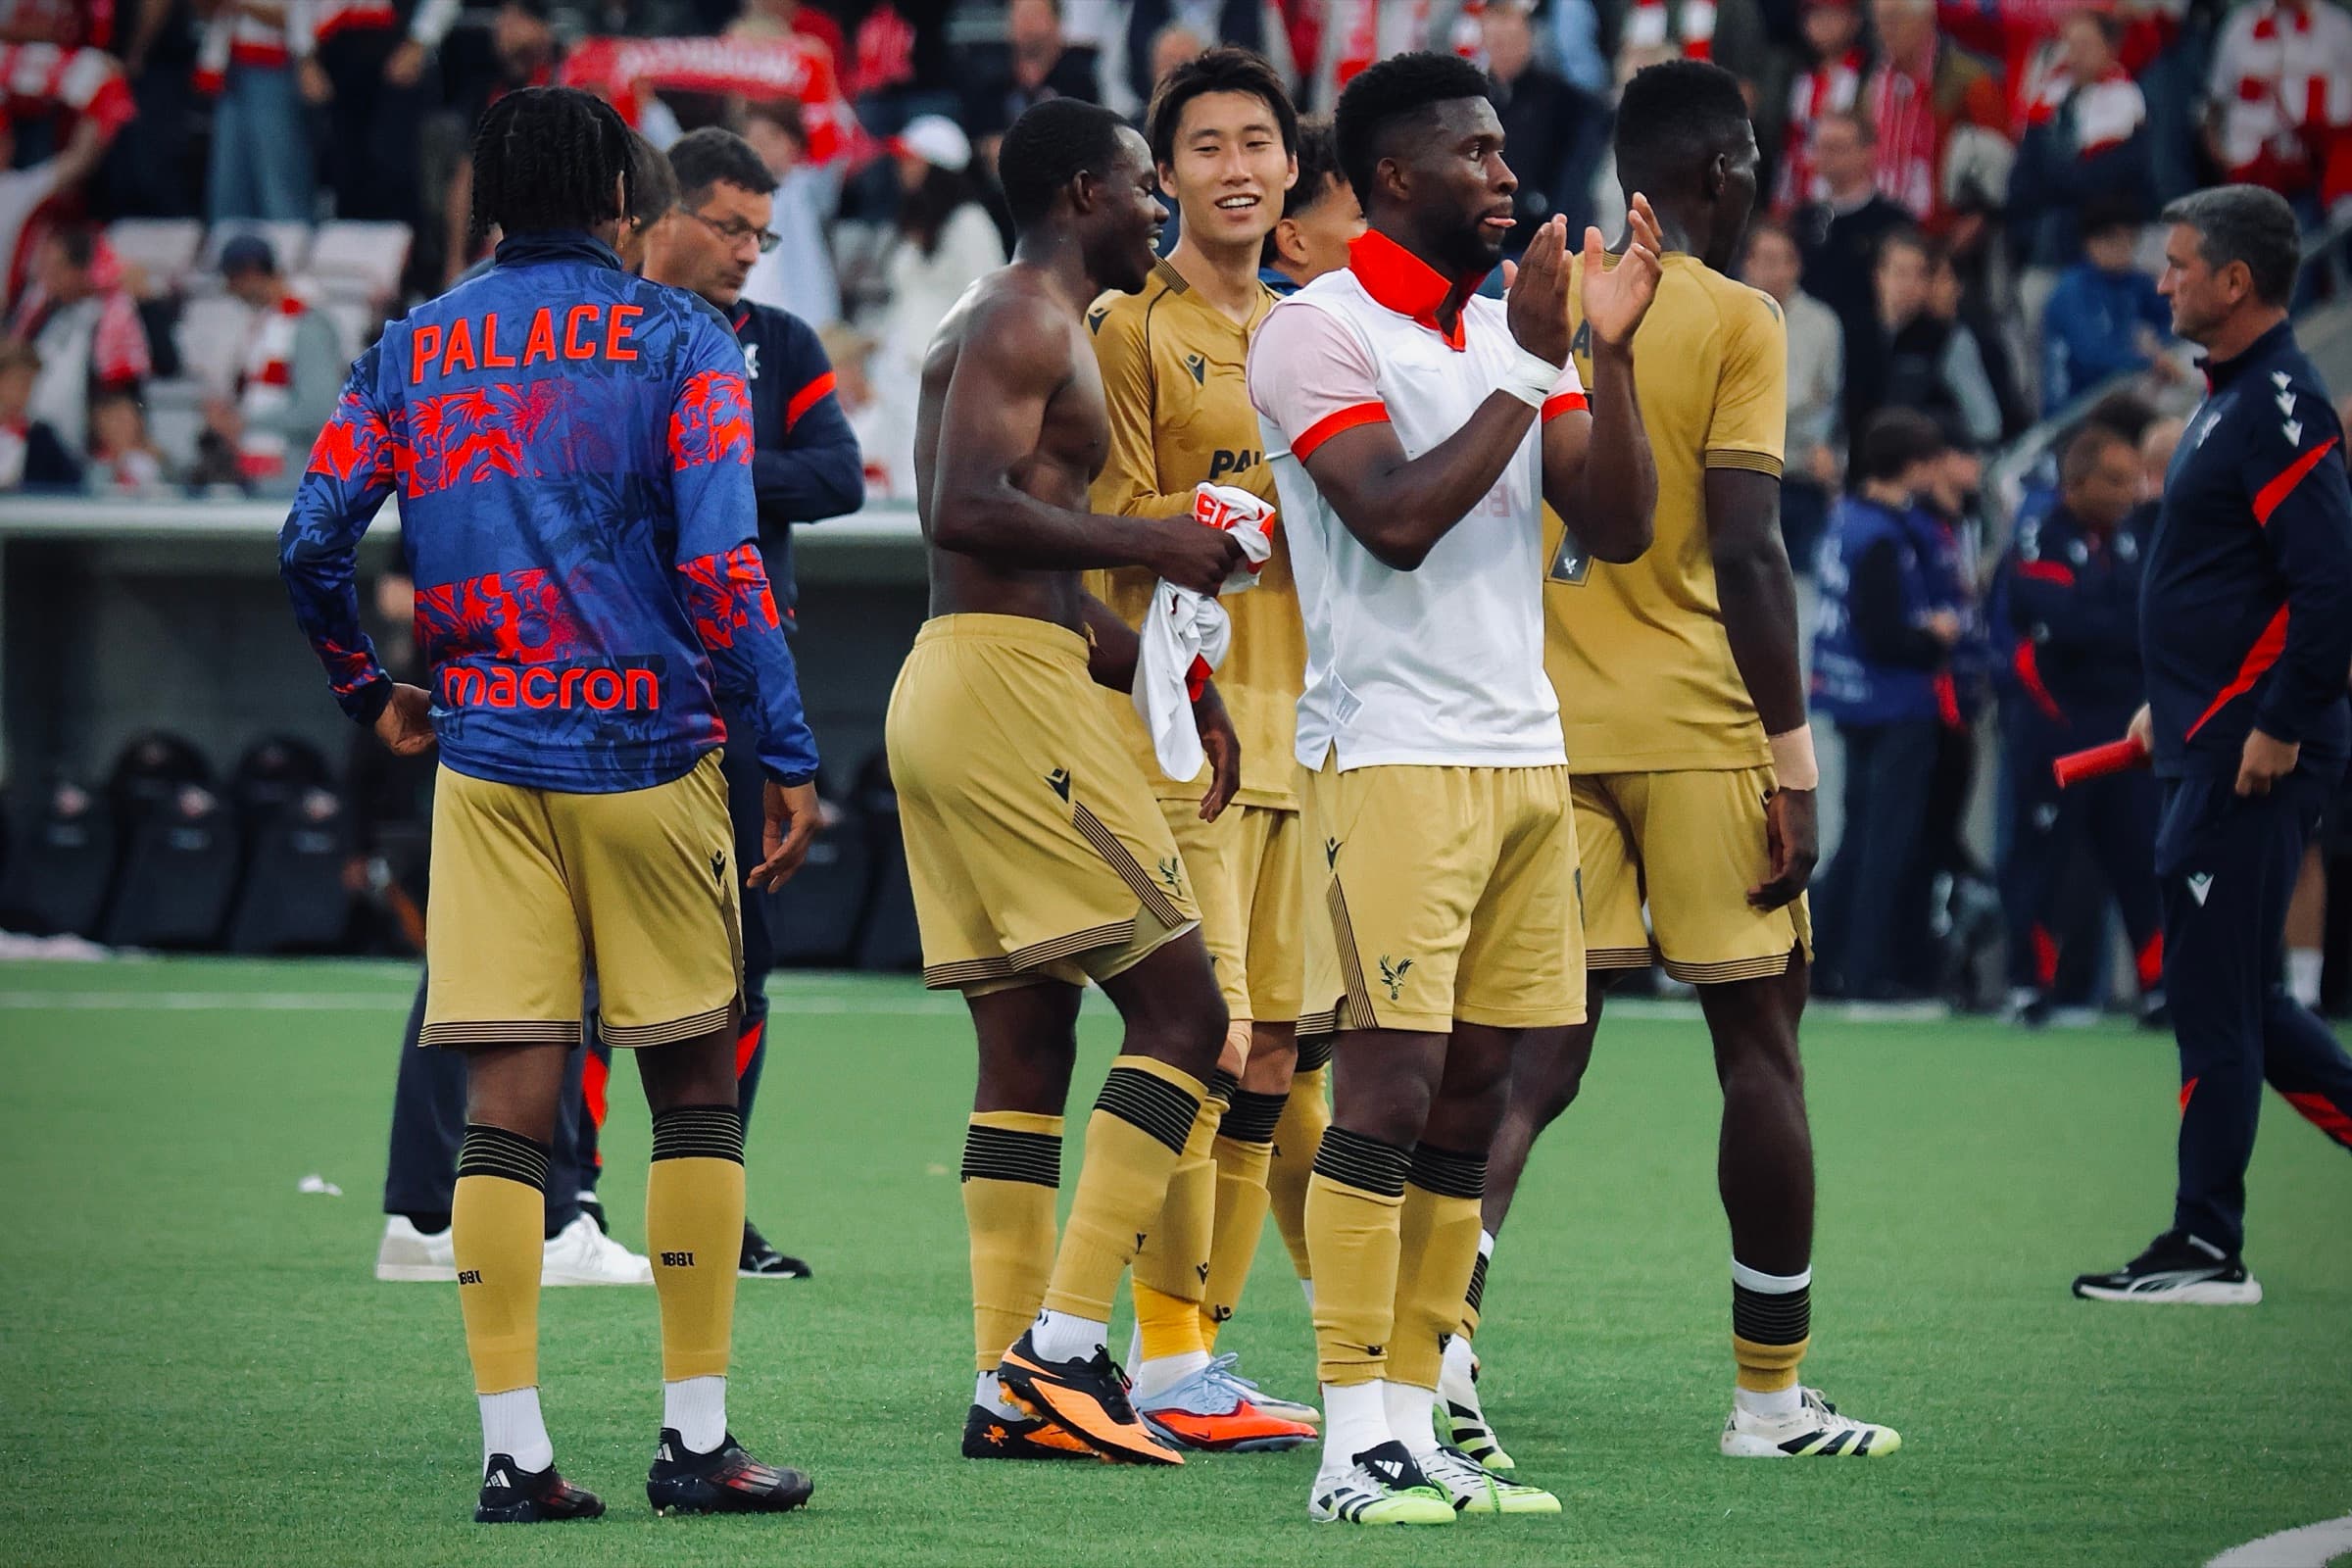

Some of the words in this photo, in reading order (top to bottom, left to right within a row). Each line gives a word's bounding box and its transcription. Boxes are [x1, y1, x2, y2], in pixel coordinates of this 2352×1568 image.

[412, 303, 643, 384] PALACE
[444, 666, 659, 710] macron
[661, 1251, 695, 1266] 1881
